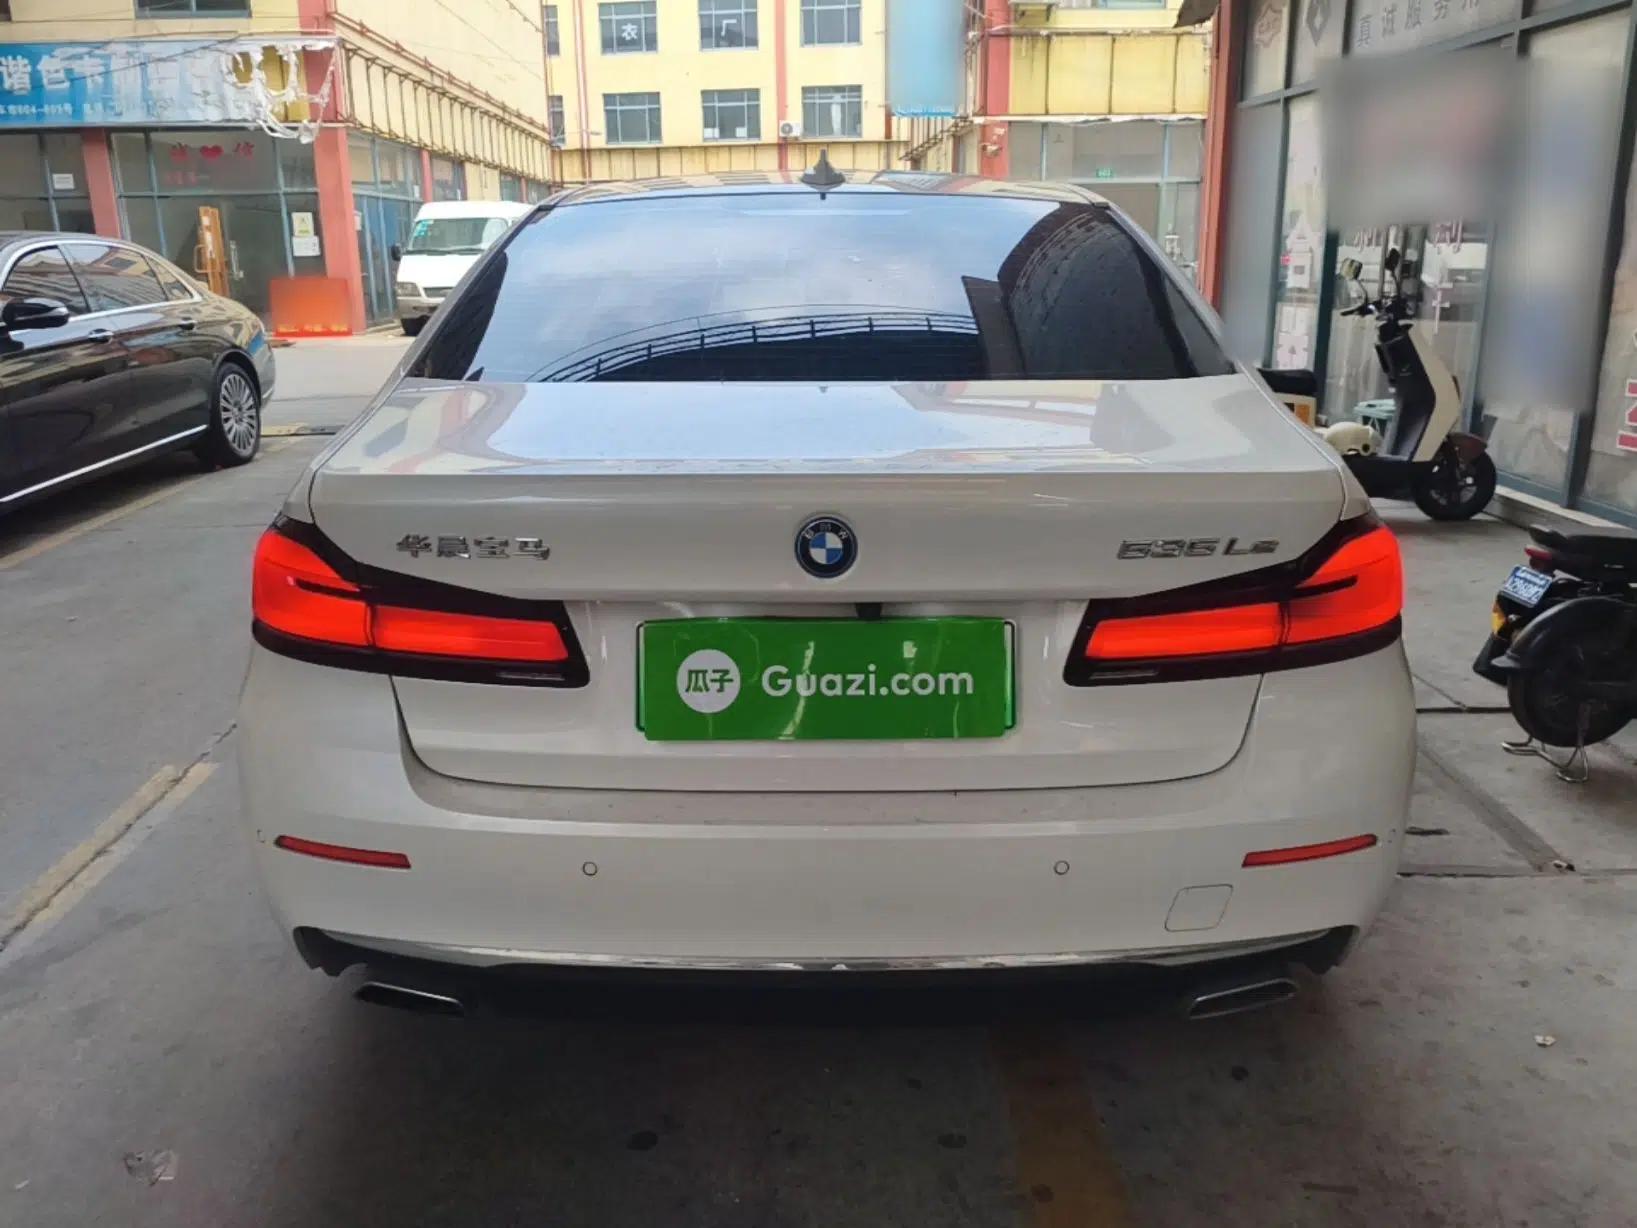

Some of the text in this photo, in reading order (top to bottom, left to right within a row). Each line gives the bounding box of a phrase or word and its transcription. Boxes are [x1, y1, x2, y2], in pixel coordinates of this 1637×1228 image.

[621, 22, 638, 40] 衣
[396, 534, 550, 560] 华晨宝马
